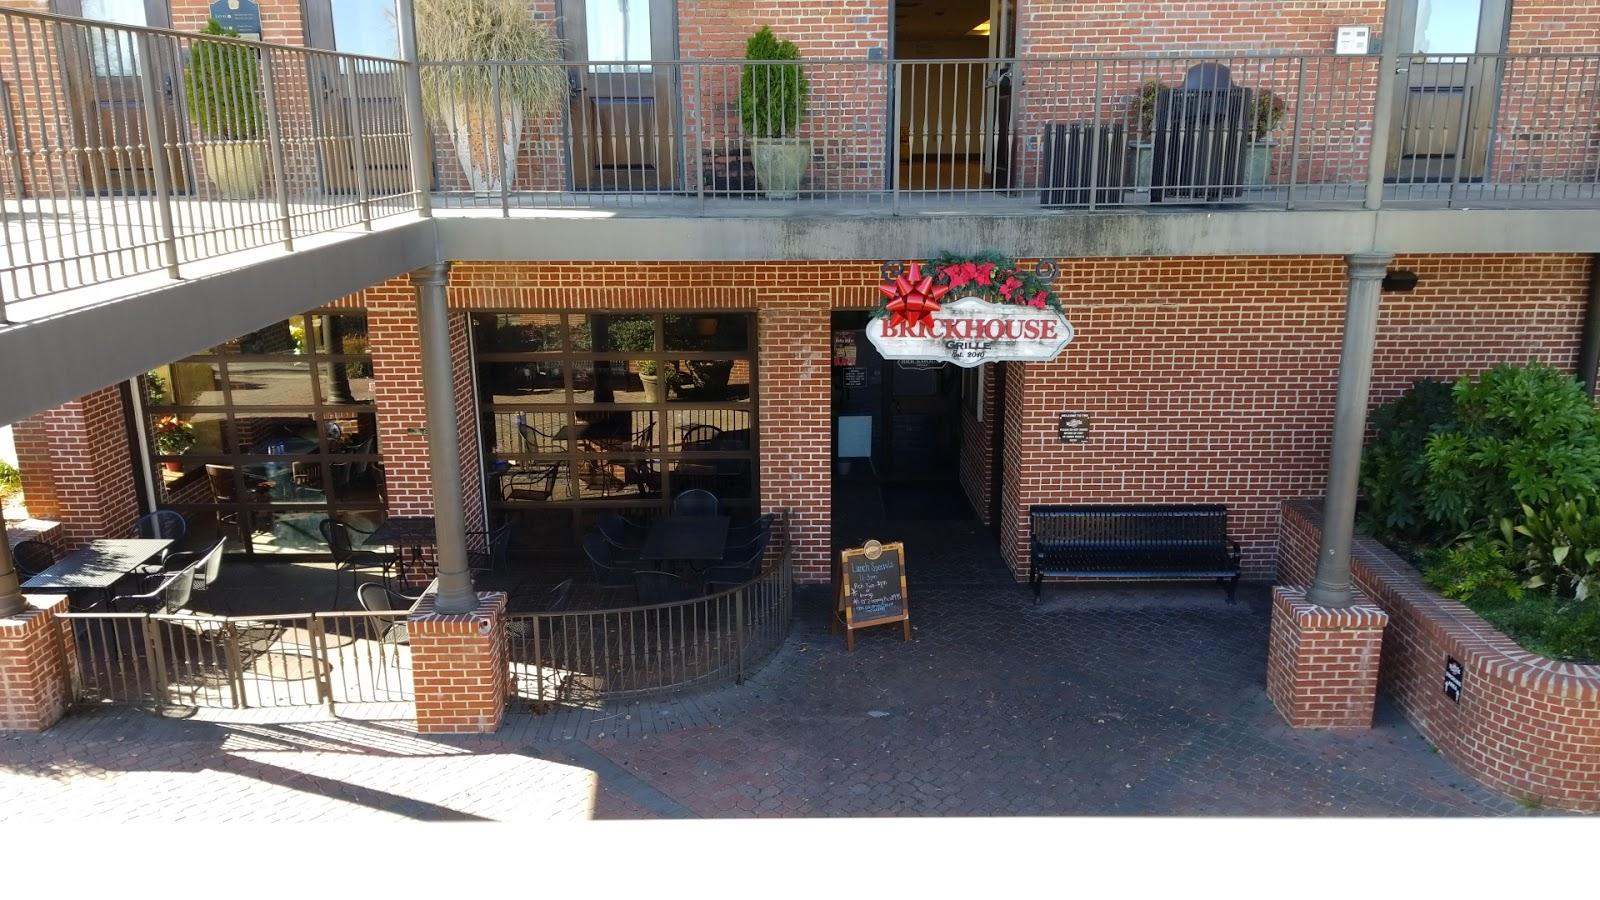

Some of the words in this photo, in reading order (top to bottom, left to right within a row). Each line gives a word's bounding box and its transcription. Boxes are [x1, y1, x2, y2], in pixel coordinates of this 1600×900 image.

[880, 318, 1058, 340] BRICKHOUSE
[945, 340, 991, 349] GRILLE
[852, 562, 870, 573] Lunch
